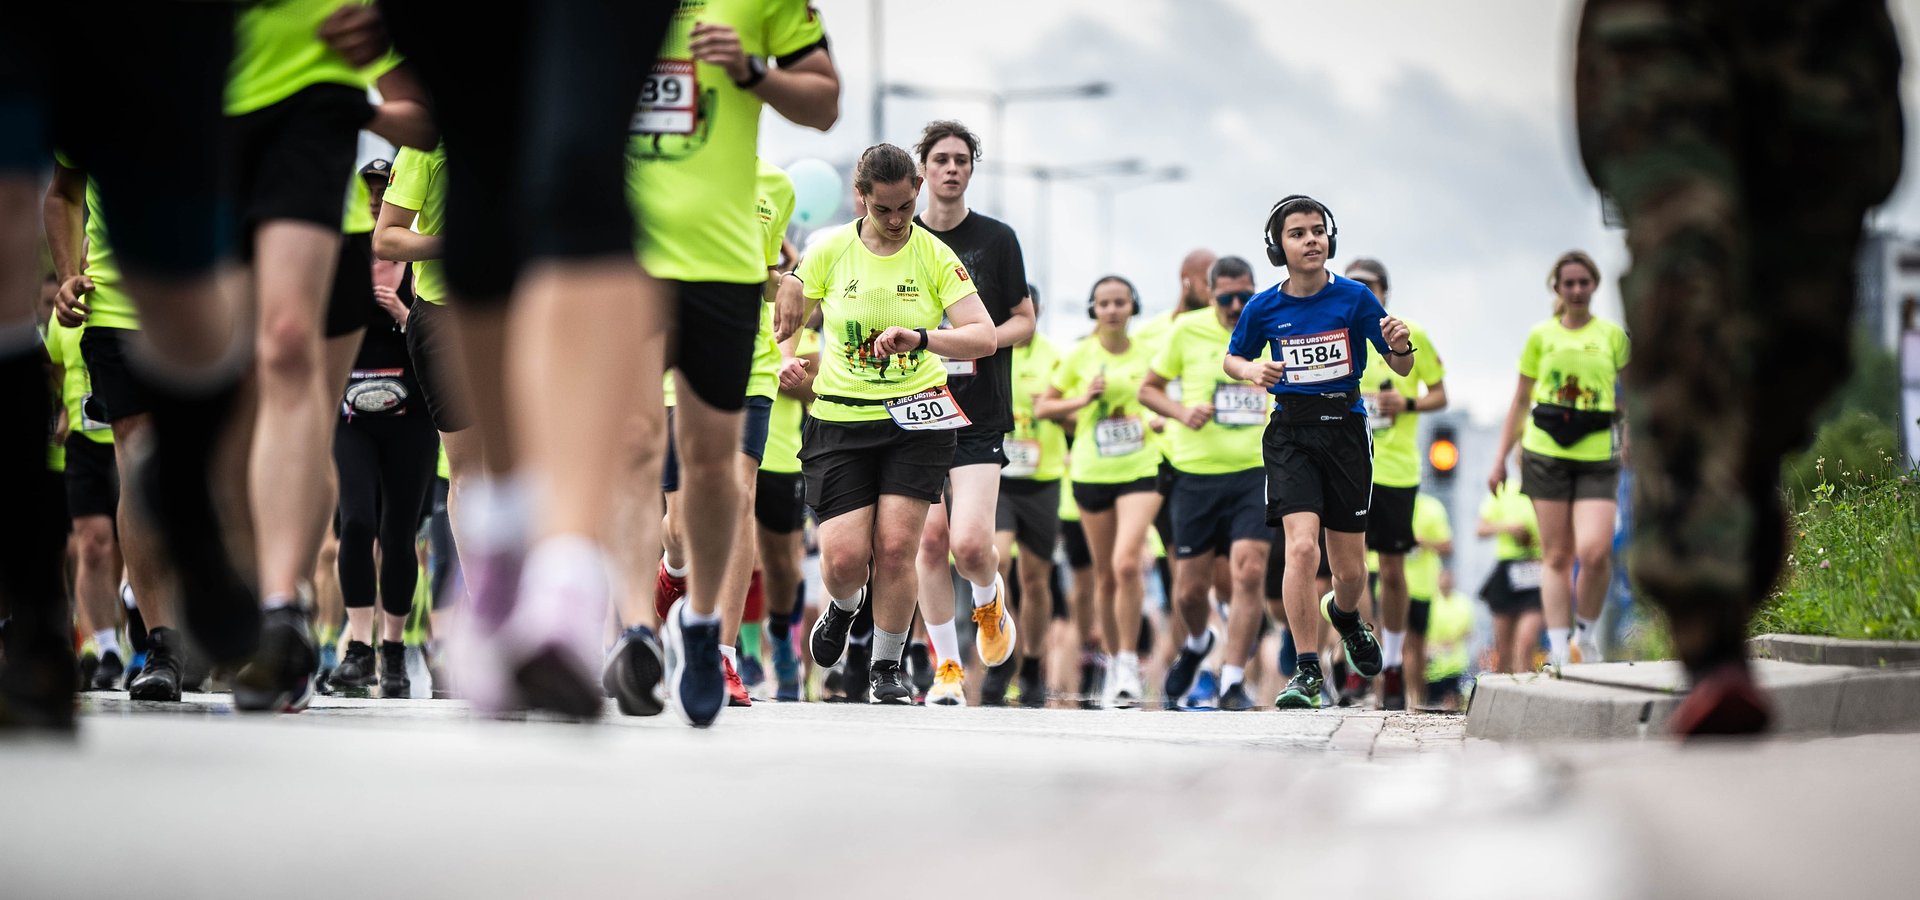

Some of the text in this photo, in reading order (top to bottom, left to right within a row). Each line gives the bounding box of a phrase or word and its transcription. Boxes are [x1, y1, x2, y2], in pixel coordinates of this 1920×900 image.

[1289, 338, 1306, 346] BIEG
[1306, 332, 1345, 345] URSYNOWA
[1289, 343, 1342, 366] 1584
[906, 401, 944, 421] 430
